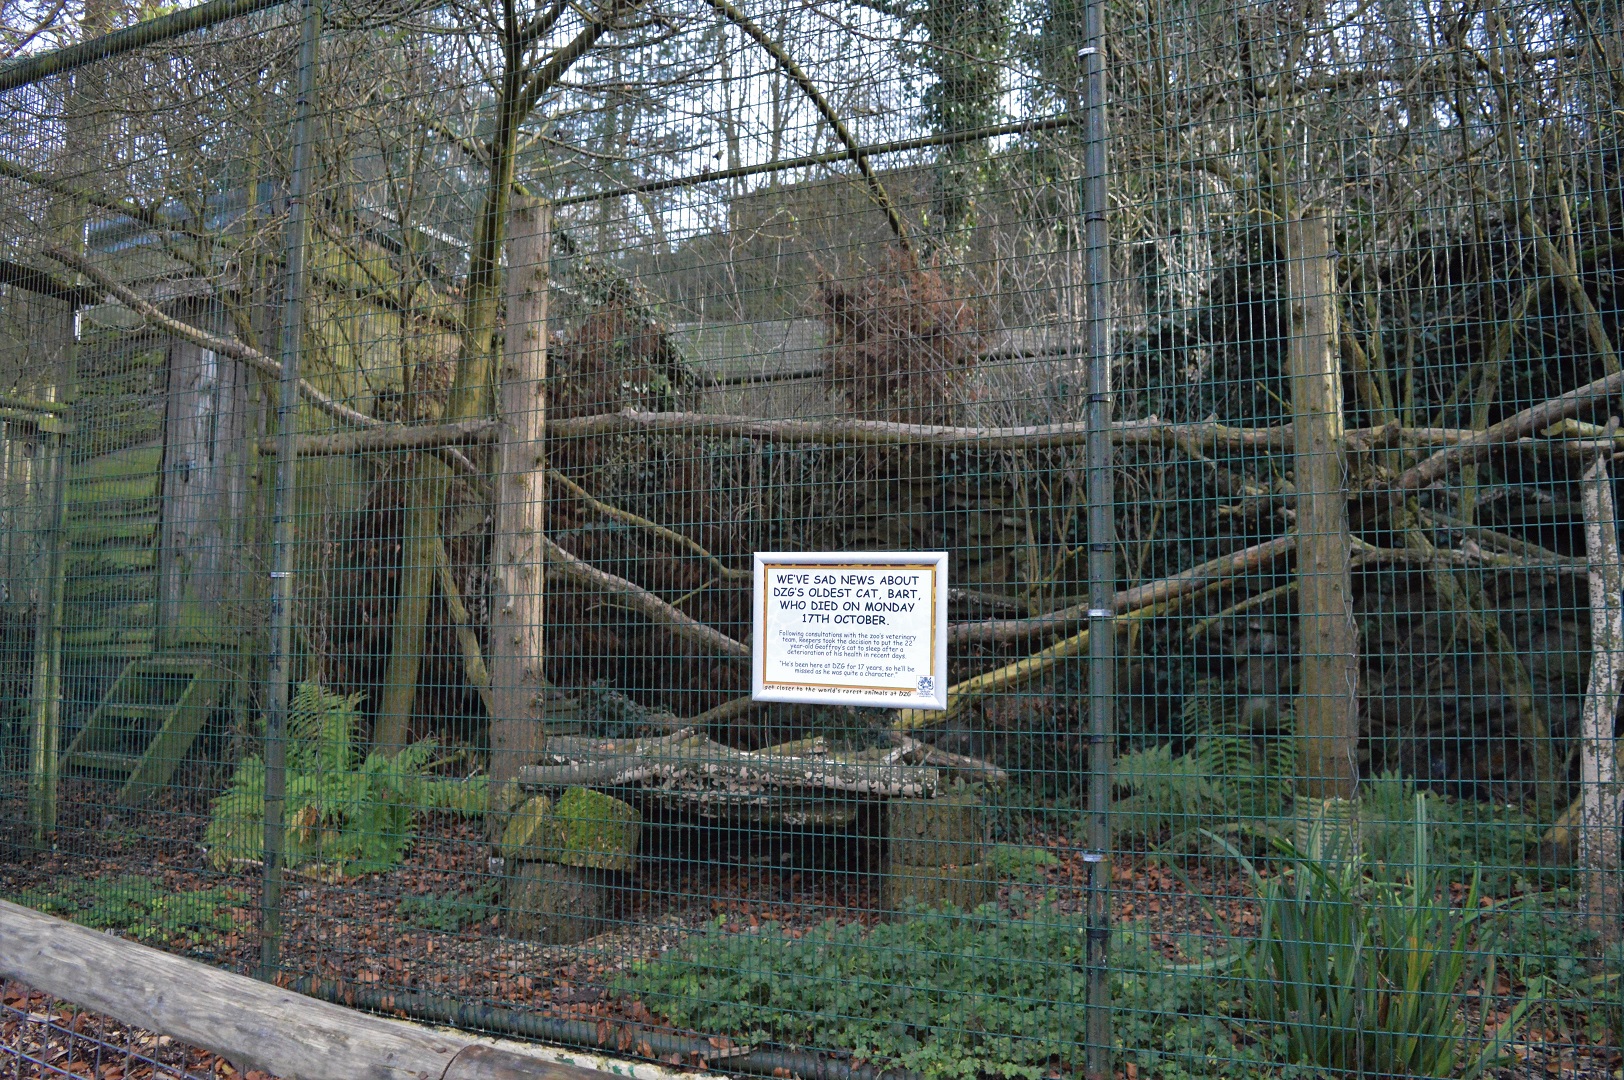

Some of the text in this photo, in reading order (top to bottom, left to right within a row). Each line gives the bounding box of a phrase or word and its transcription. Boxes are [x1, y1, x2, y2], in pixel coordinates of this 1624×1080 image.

[777, 574, 919, 585] WE'VE SAD NEWS ABOUT
[774, 588, 921, 600] DZG'S OLDEST CAT, BART,
[780, 601, 915, 612] WHO DIED ON MONDAY
[802, 614, 889, 626] 17TH OCTOBER.
[779, 630, 804, 638] Following
[805, 631, 842, 639] consultations
[790, 643, 813, 651] year-old
[815, 644, 845, 652] Geoffroy's
[866, 645, 881, 653] sleep
